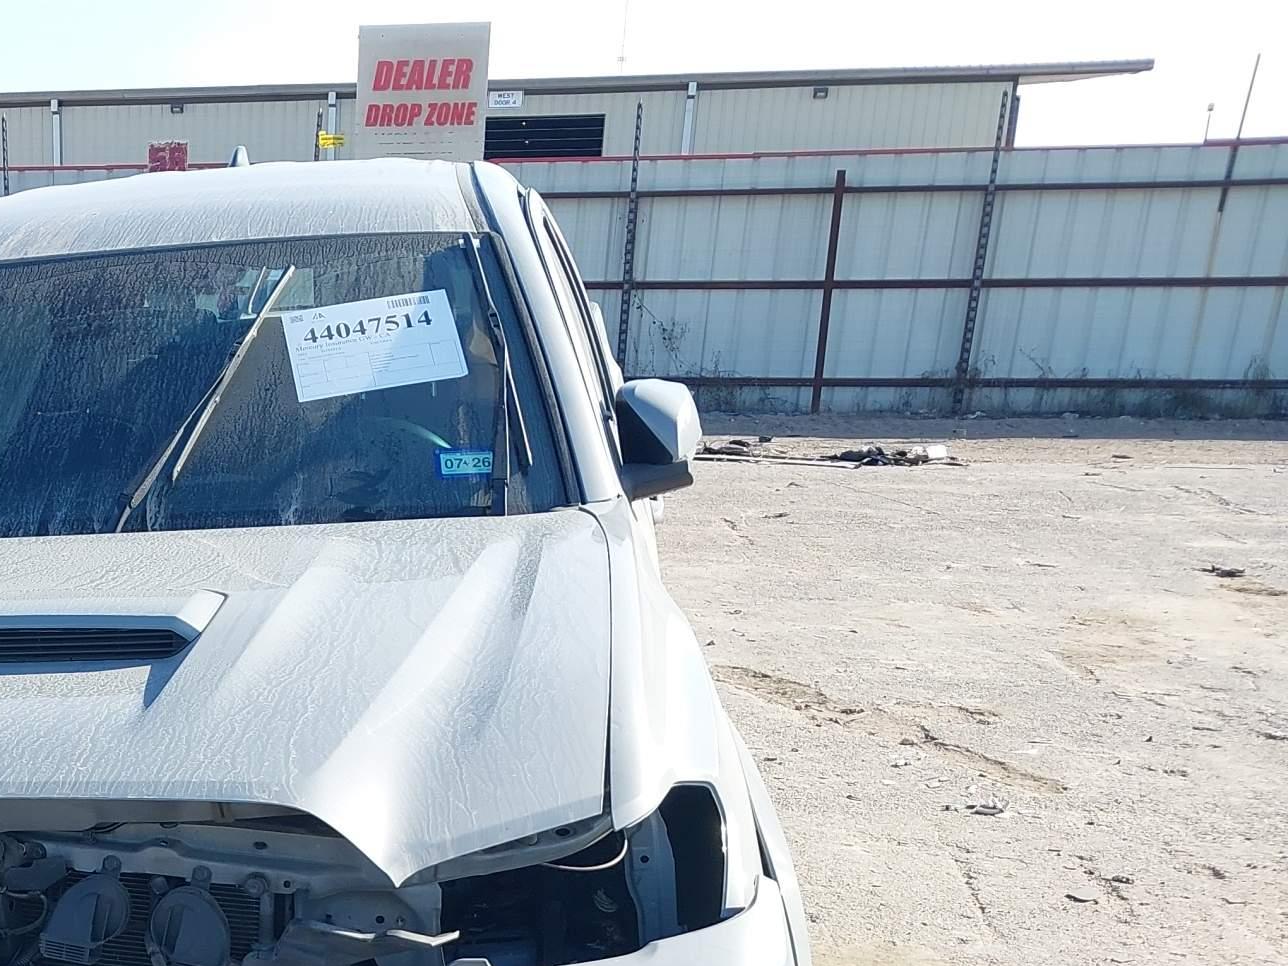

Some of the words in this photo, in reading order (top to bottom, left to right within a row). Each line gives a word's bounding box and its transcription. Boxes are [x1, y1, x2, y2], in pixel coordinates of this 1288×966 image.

[372, 58, 474, 91] DEALER
[365, 103, 422, 127] DROP
[424, 102, 478, 126] ZONE
[303, 310, 432, 343] 44047514
[445, 458, 463, 469] 07
[472, 457, 491, 468] 26
